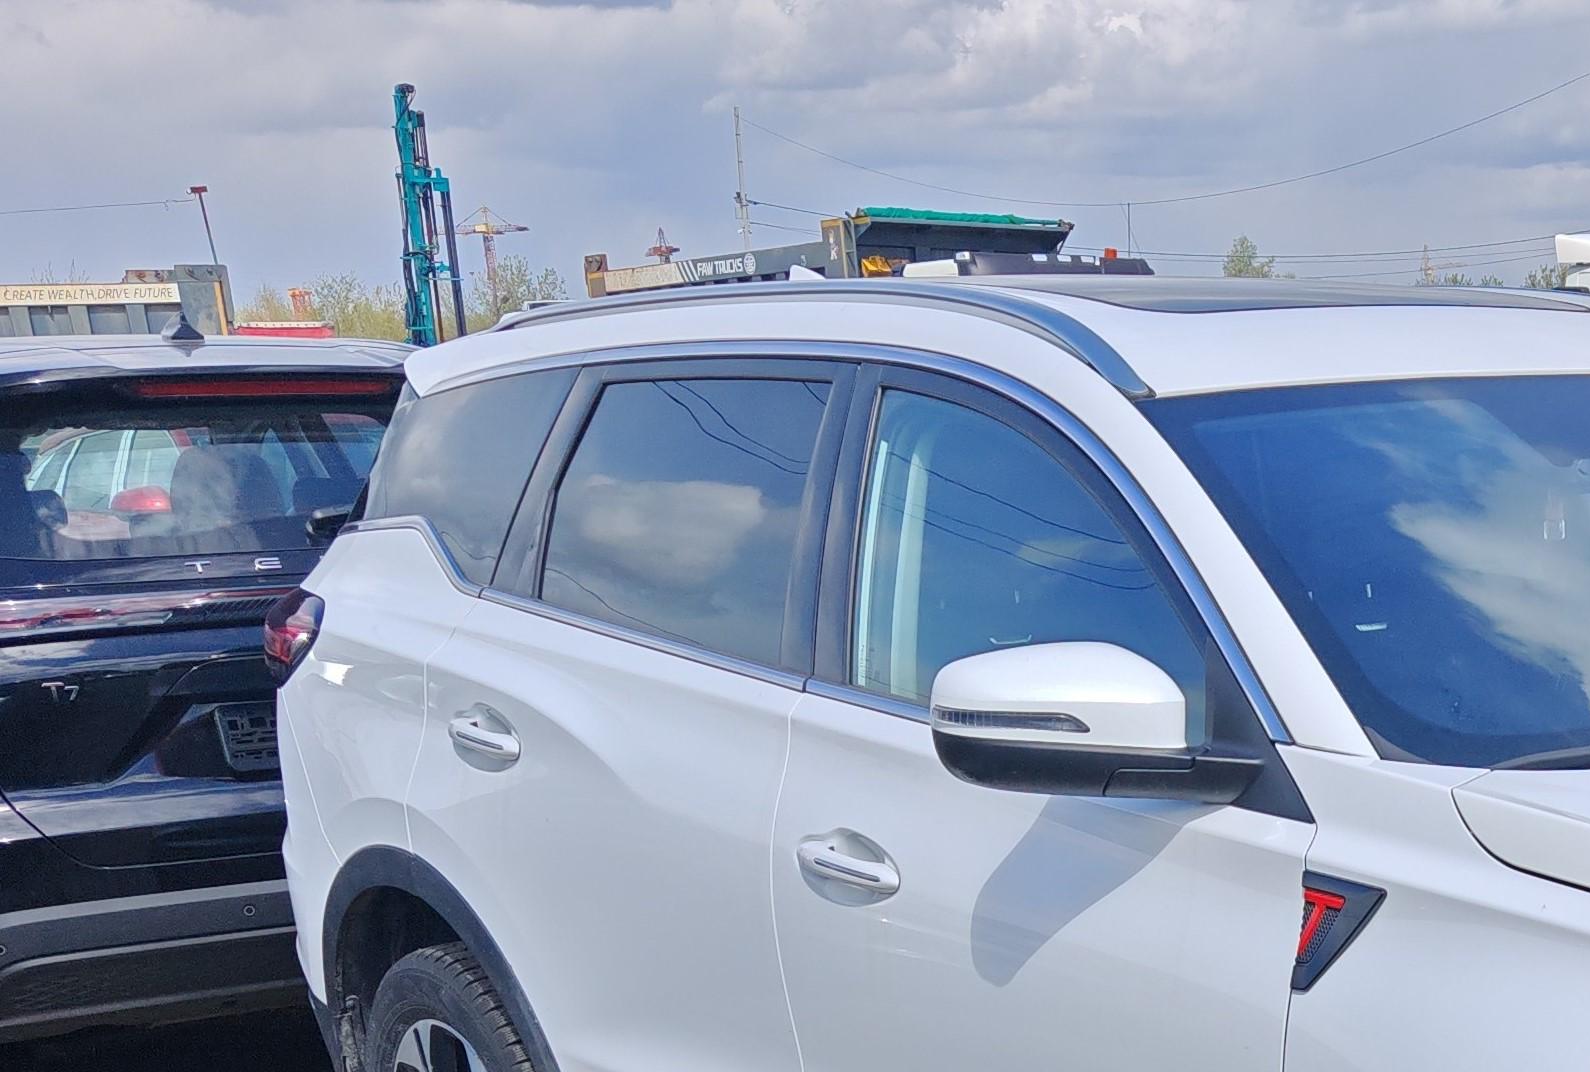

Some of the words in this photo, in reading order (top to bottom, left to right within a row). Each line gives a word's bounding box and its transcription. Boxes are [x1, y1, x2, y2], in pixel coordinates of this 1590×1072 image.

[697, 261, 713, 276] FAW
[714, 258, 744, 274] TRUCKS
[3, 287, 44, 301] CREATE
[134, 287, 174, 299] FUTURE
[41, 681, 80, 701] T7
